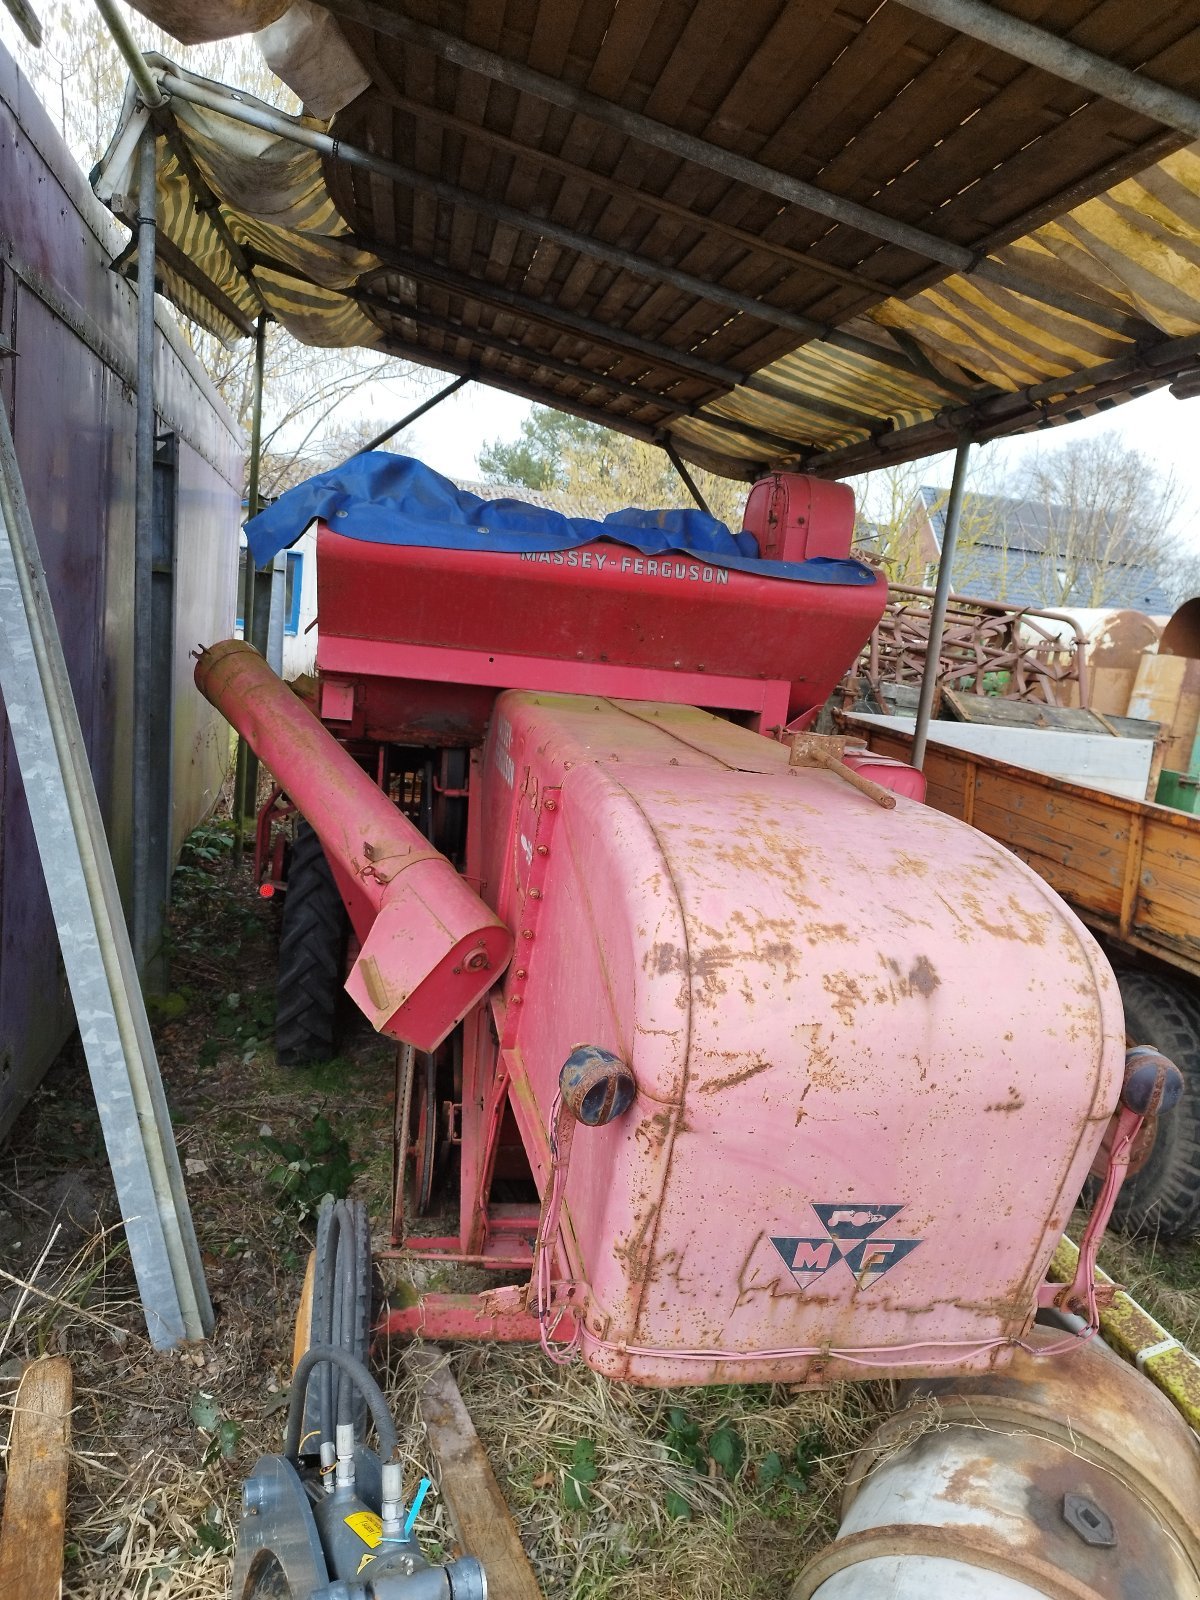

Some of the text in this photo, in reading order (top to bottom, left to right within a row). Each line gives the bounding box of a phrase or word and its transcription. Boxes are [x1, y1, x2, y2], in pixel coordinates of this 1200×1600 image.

[520, 551, 729, 584] MASSEY-FERGUSON
[792, 1242, 896, 1270] M F
